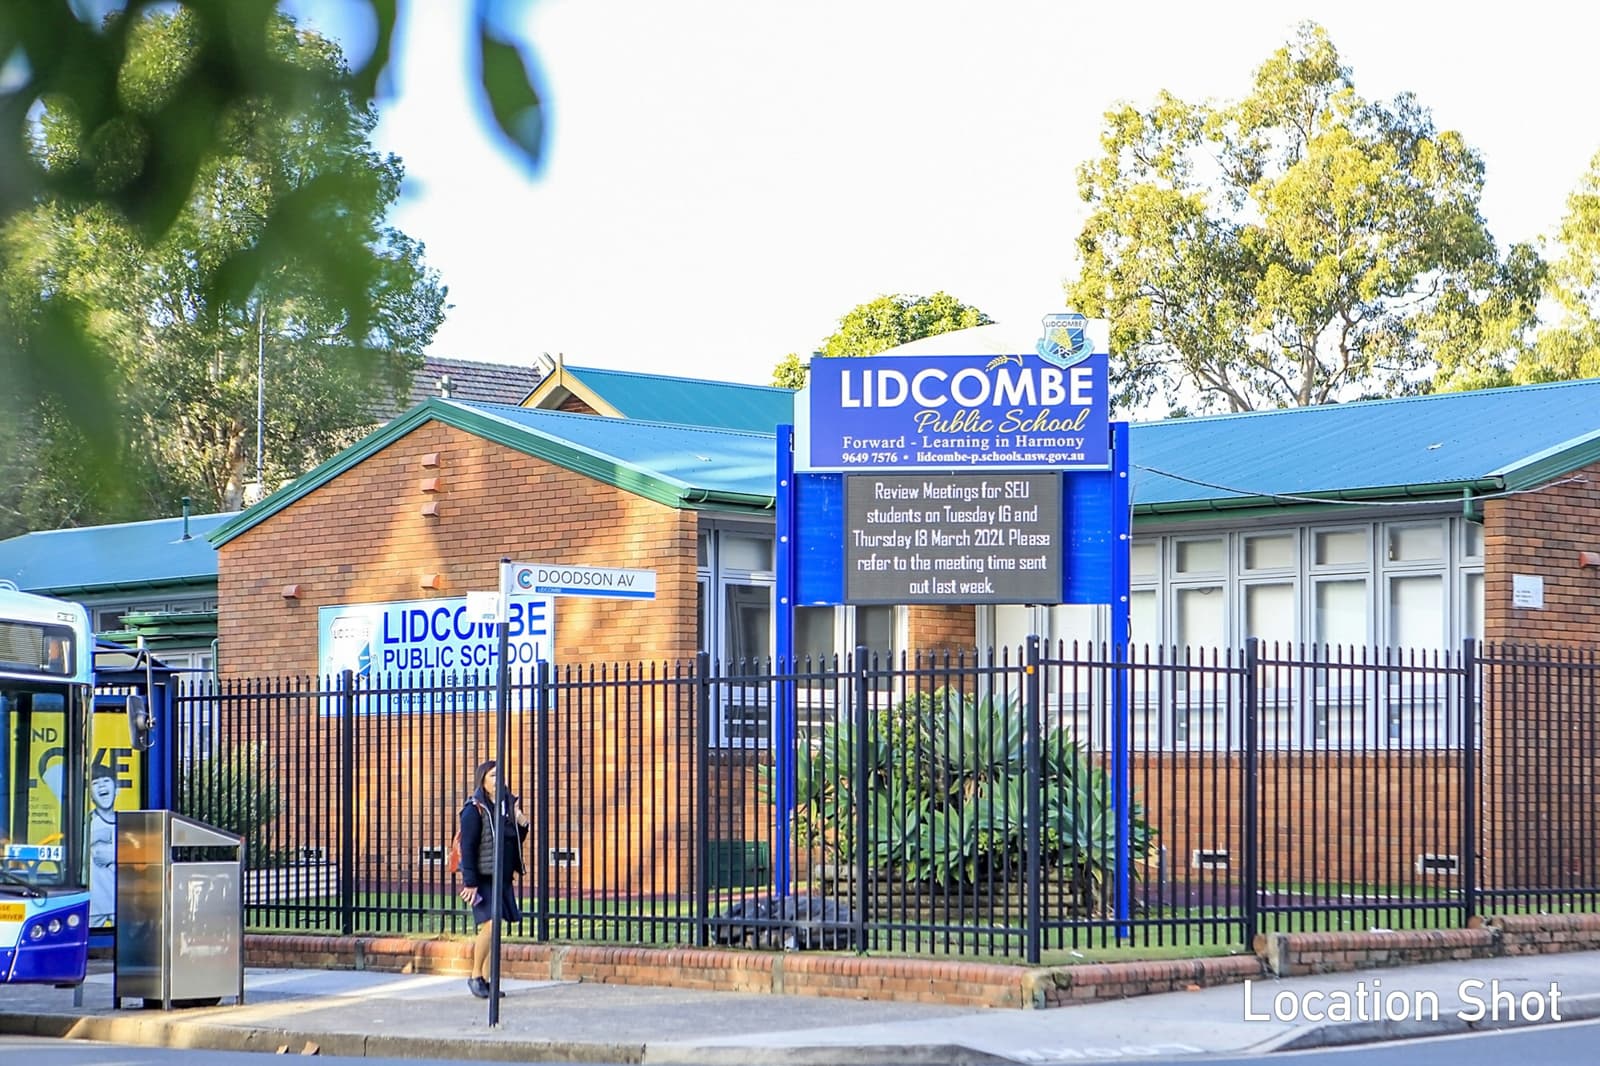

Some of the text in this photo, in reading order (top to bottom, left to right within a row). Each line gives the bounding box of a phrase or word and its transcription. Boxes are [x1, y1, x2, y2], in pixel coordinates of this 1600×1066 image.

[841, 367, 1093, 408] LIDCOMBE
[913, 408, 1091, 434] Public School
[842, 435, 905, 449] Forward
[922, 435, 990, 451] Learning
[995, 434, 1009, 448] in
[1015, 434, 1085, 450] Harmony
[841, 451, 1086, 465] 9649 7576 lidcombe-p.schools.nsw.gov.au
[875, 482, 919, 499] Review
[923, 482, 979, 502] Meetings
[982, 481, 1002, 499] for
[867, 505, 1038, 525] students on Tuesday 16 and
[852, 530, 912, 549] Thursday
[915, 530, 928, 546] 18
[931, 530, 971, 546] March
[1008, 529, 1051, 546] Please
[857, 554, 1047, 573] refer to the meeting time sent
[538, 569, 635, 587] DOODSON AV
[909, 577, 995, 594] out last week.
[384, 646, 454, 671] PUBLIC
